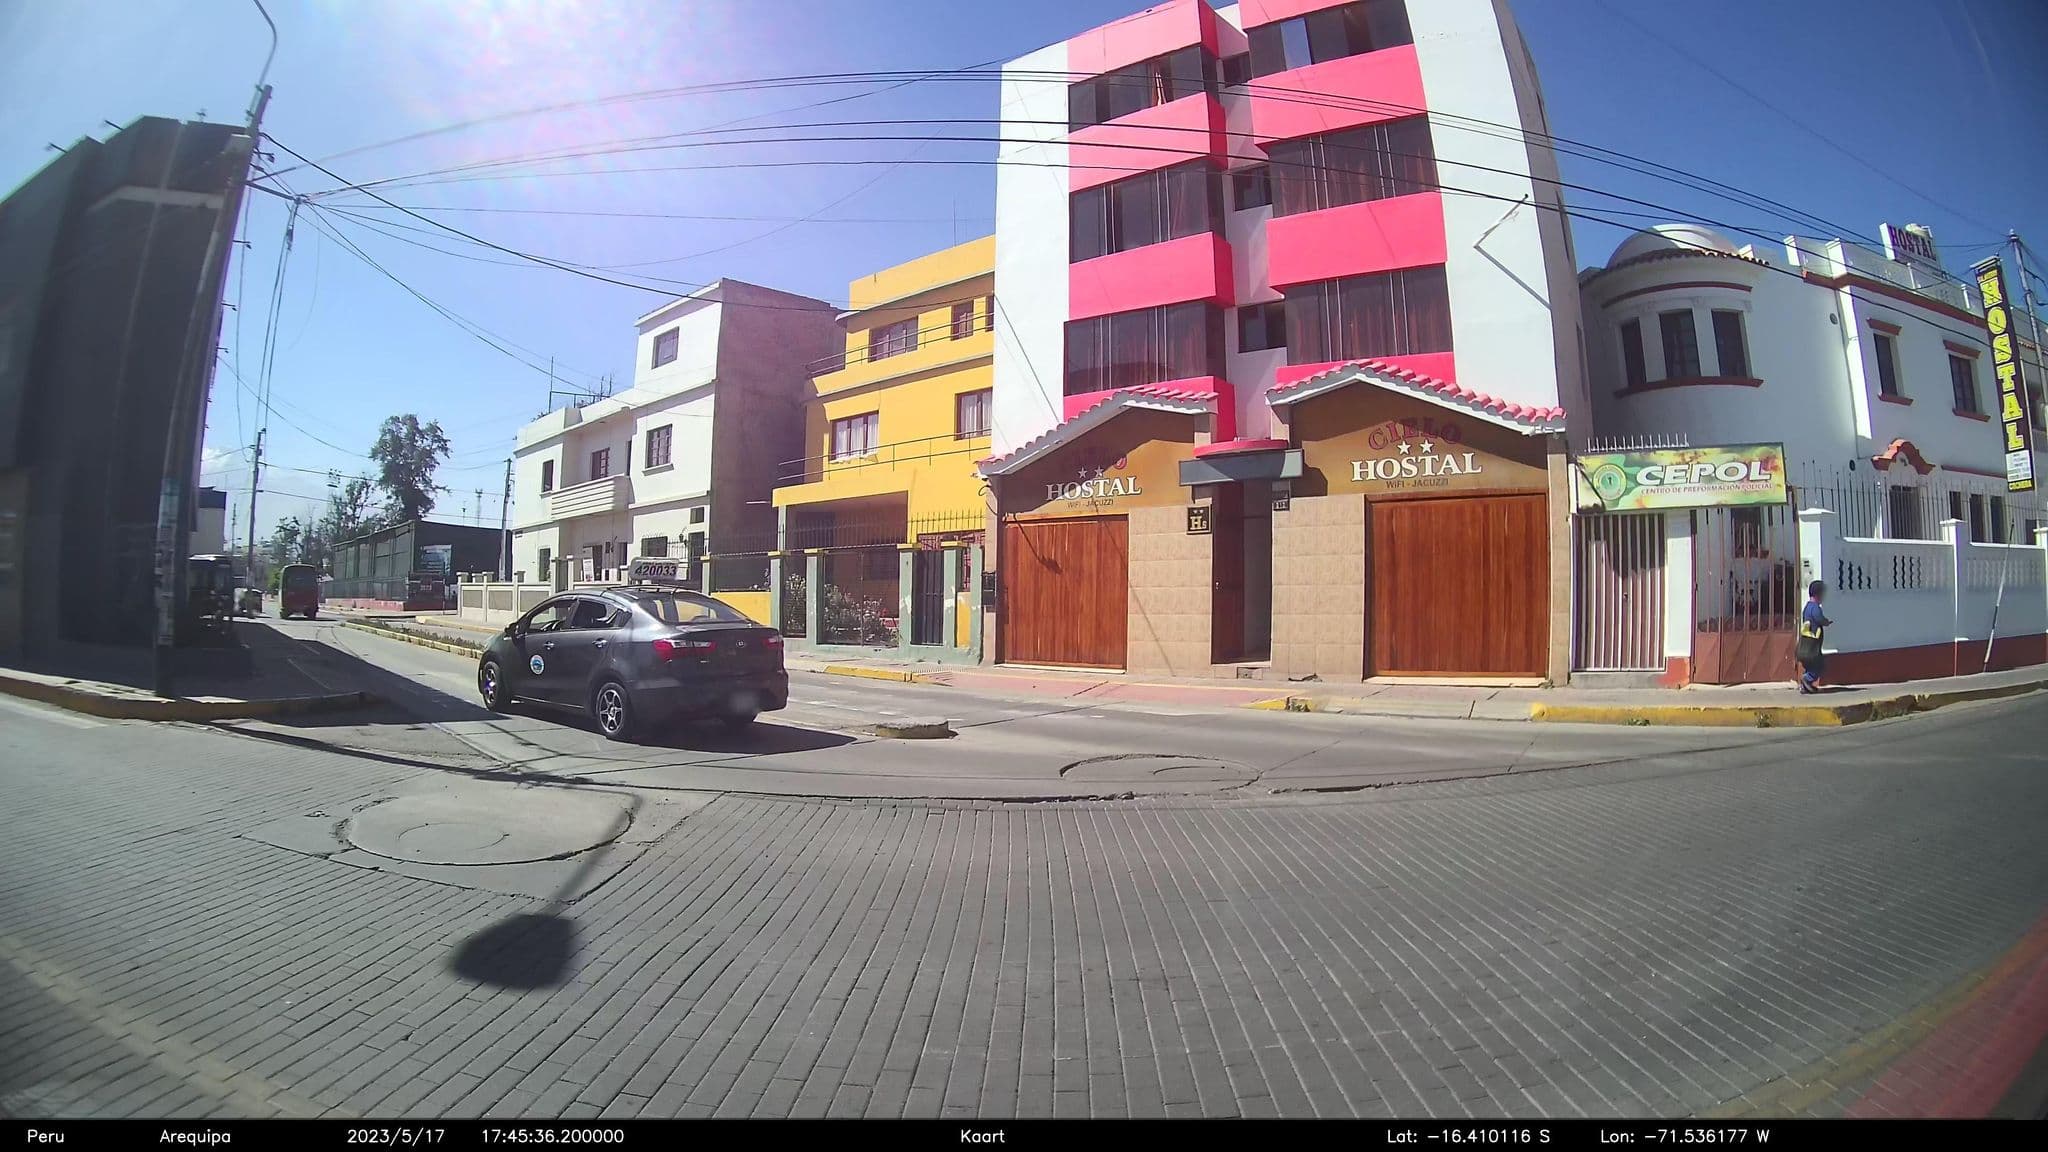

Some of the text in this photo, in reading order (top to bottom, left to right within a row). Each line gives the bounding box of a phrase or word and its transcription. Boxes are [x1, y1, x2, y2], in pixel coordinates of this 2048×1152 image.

[1887, 225, 1936, 261] HOSTAL
[1980, 278, 2025, 451] HOSTAL
[1368, 417, 1462, 450] CIELO
[1351, 452, 1482, 481] HOSTAL
[1636, 461, 1771, 486] CEPOL
[1046, 476, 1142, 501] HOSTAL
[1412, 479, 1449, 488] JACUZZI
[635, 565, 677, 576] 420033
